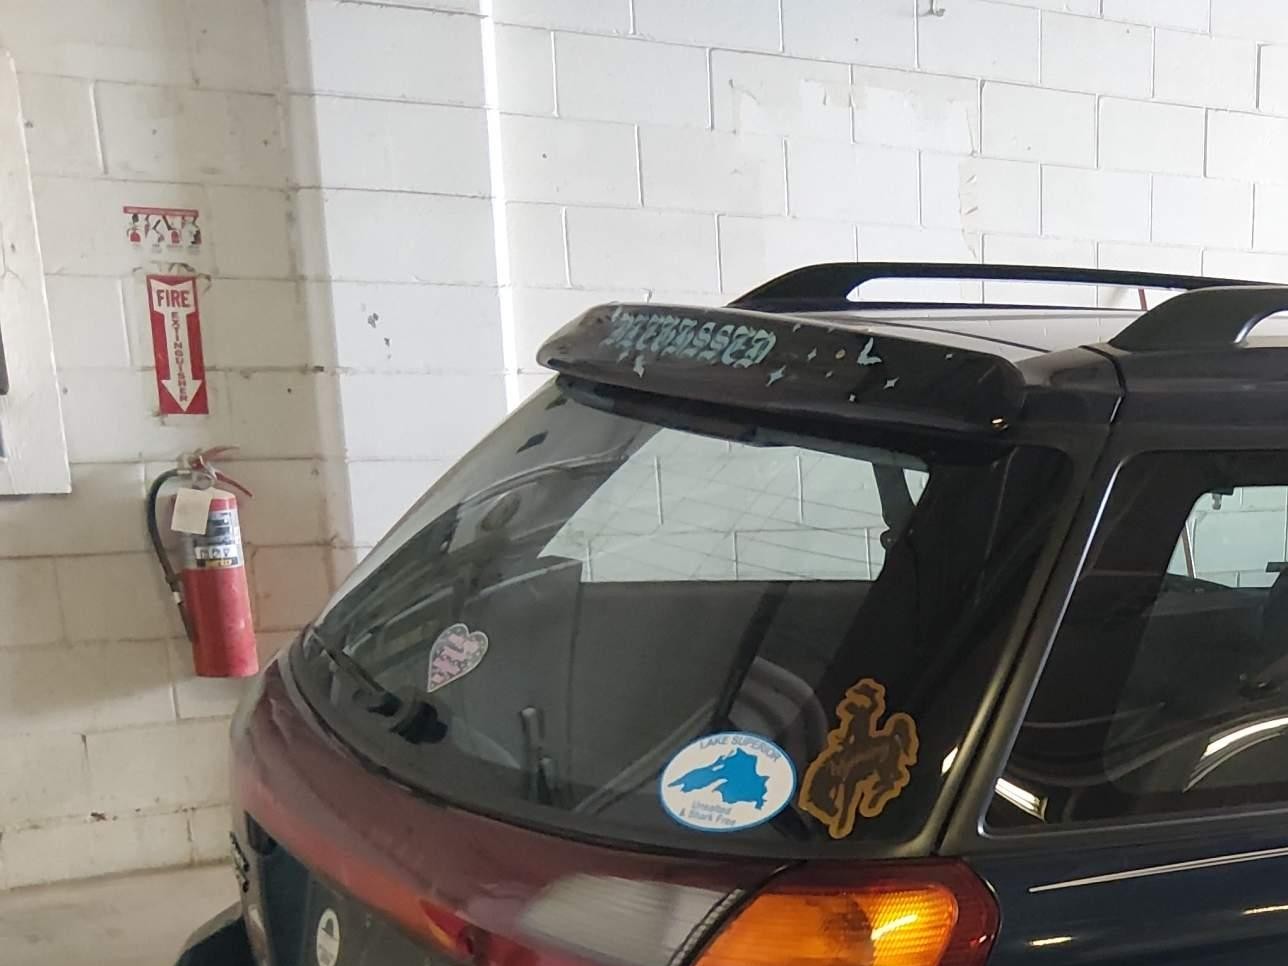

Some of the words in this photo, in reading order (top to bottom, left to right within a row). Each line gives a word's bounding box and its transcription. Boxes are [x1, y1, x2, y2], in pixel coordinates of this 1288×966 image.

[156, 289, 192, 308] FIRE
[171, 311, 188, 402] EXTINGUISHER
[700, 735, 731, 750] LAKE
[731, 735, 781, 762] SUPERIOR
